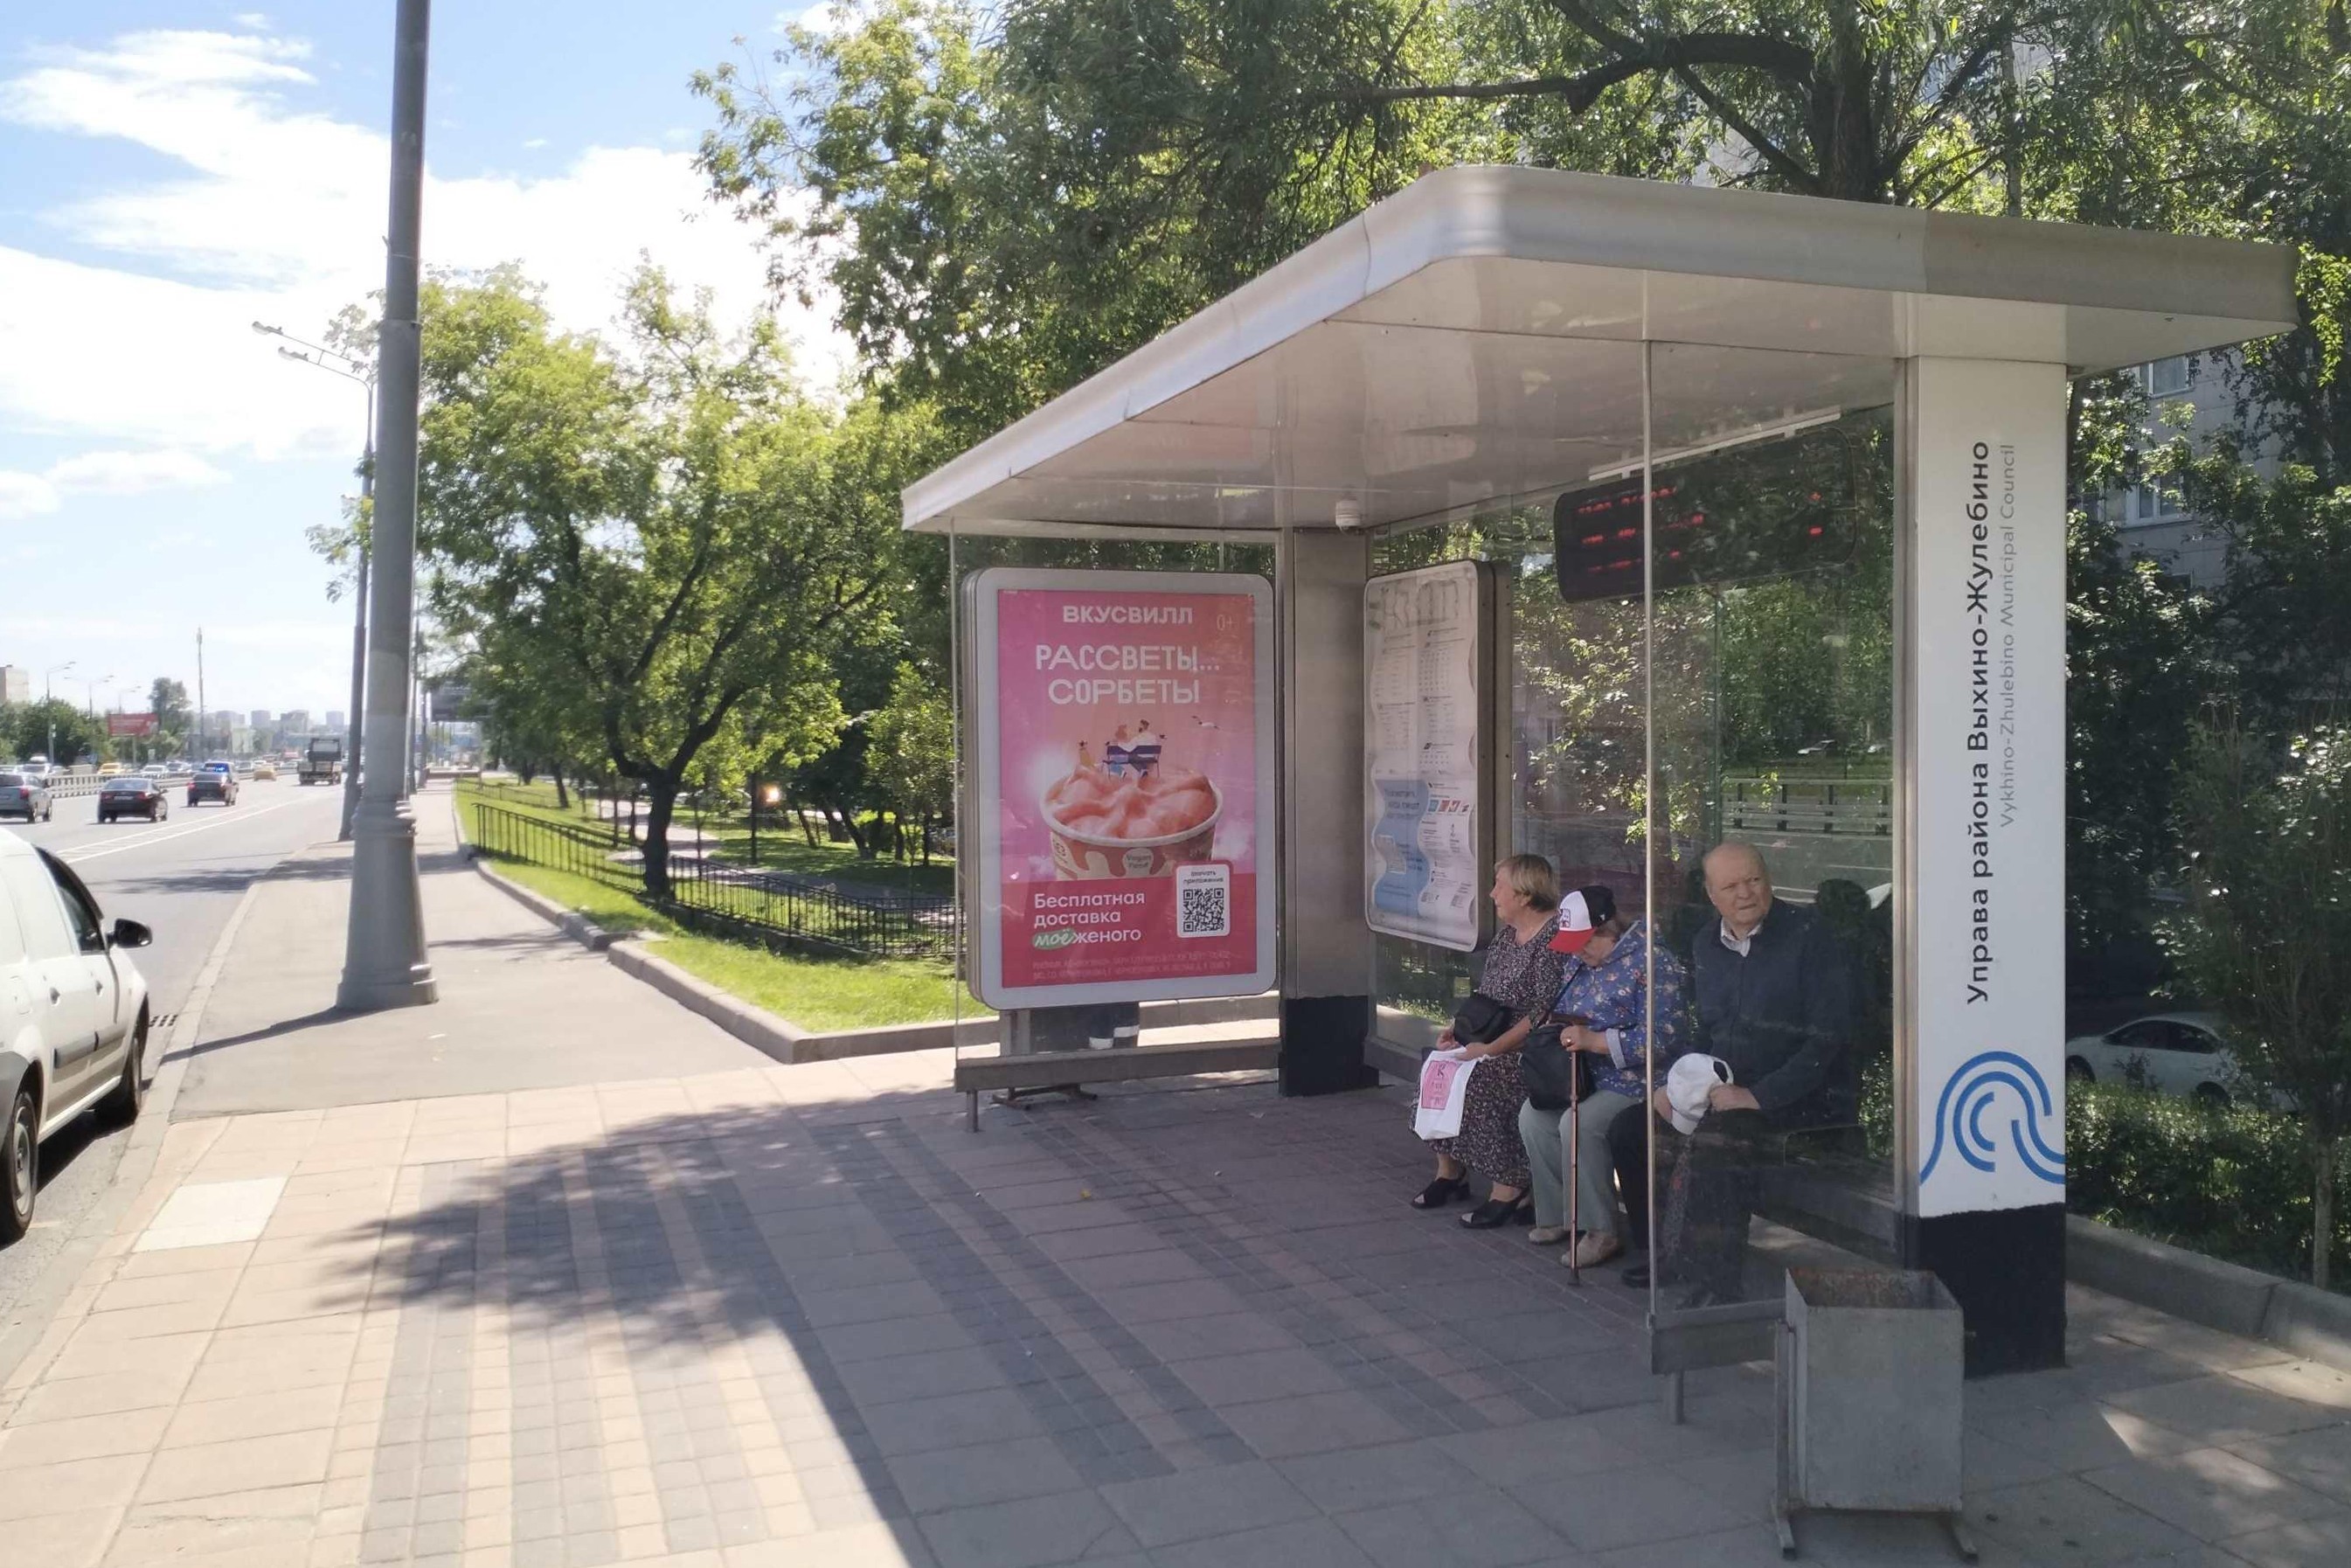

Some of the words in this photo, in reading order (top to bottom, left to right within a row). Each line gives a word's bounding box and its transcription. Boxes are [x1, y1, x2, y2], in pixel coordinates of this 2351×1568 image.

[2000, 444, 2015, 519] Council
[1966, 441, 1994, 751] Выхино-Жулебино
[2000, 526, 2017, 627] Municipal
[1063, 605, 1193, 624] ВКУСВИЛЛ
[1036, 644, 1220, 671] РАССВЕТЫ...
[1048, 678, 1200, 704] СОРБЕТЫ
[2000, 635, 2017, 828] Vykhino-Zhulebino
[1967, 762, 1994, 878] района
[1034, 892, 1146, 909] Бесплатная
[1034, 910, 1121, 928] доставка
[1966, 889, 1994, 1004] Управа
